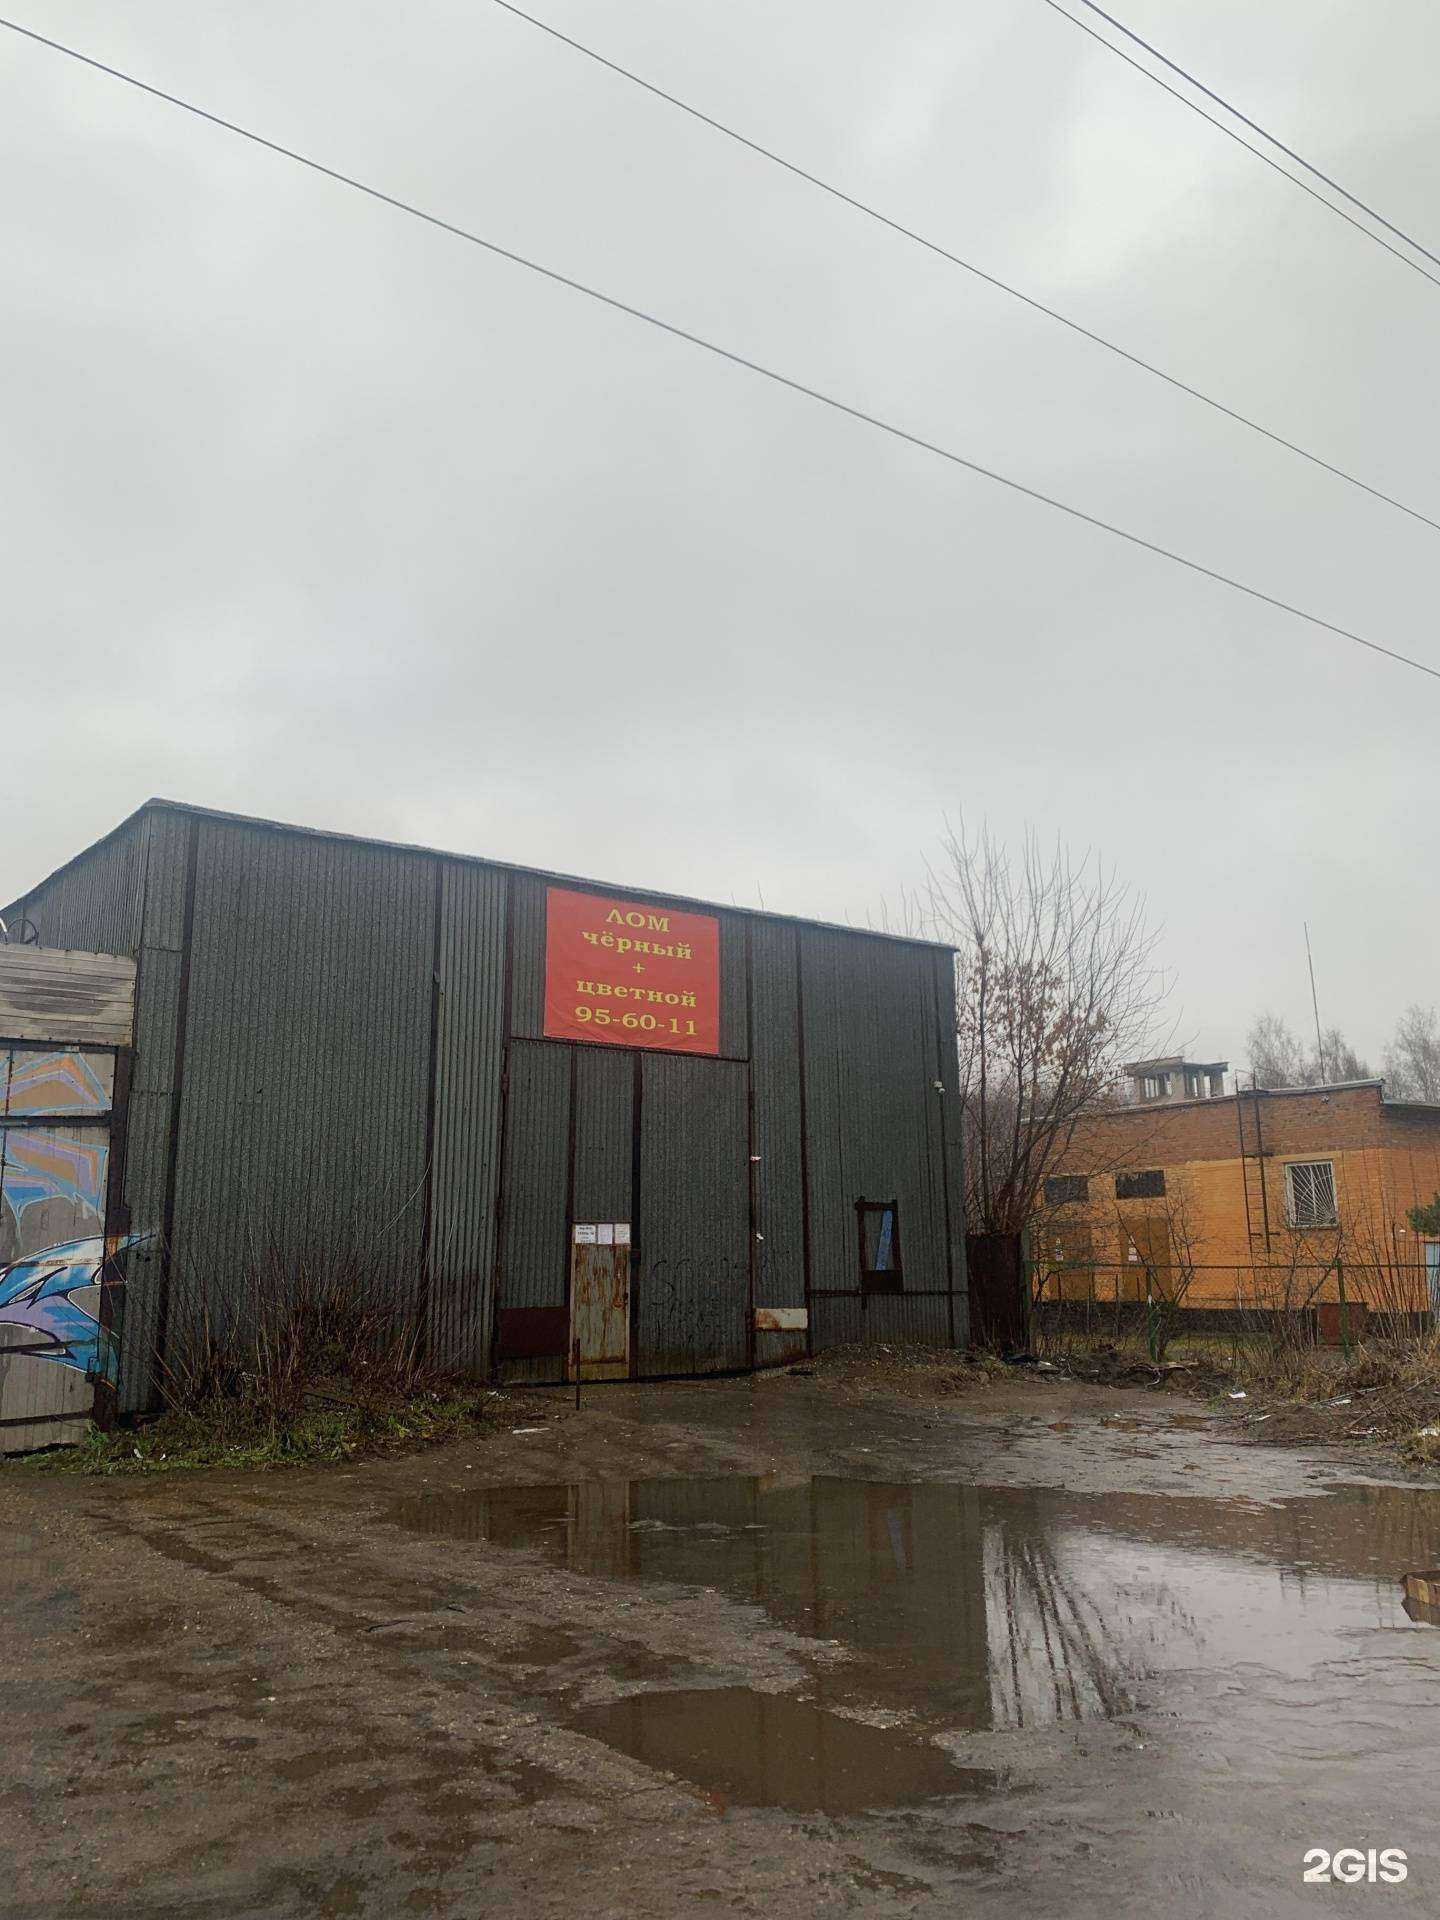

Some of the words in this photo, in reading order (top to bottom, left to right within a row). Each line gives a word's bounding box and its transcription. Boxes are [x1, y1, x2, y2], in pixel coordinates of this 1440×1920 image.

[606, 909, 670, 932] ЛОМ
[582, 930, 692, 960] чёрный
[632, 962, 646, 973] +
[576, 980, 697, 1007] цветной
[575, 1006, 697, 1035] 95-60-11
